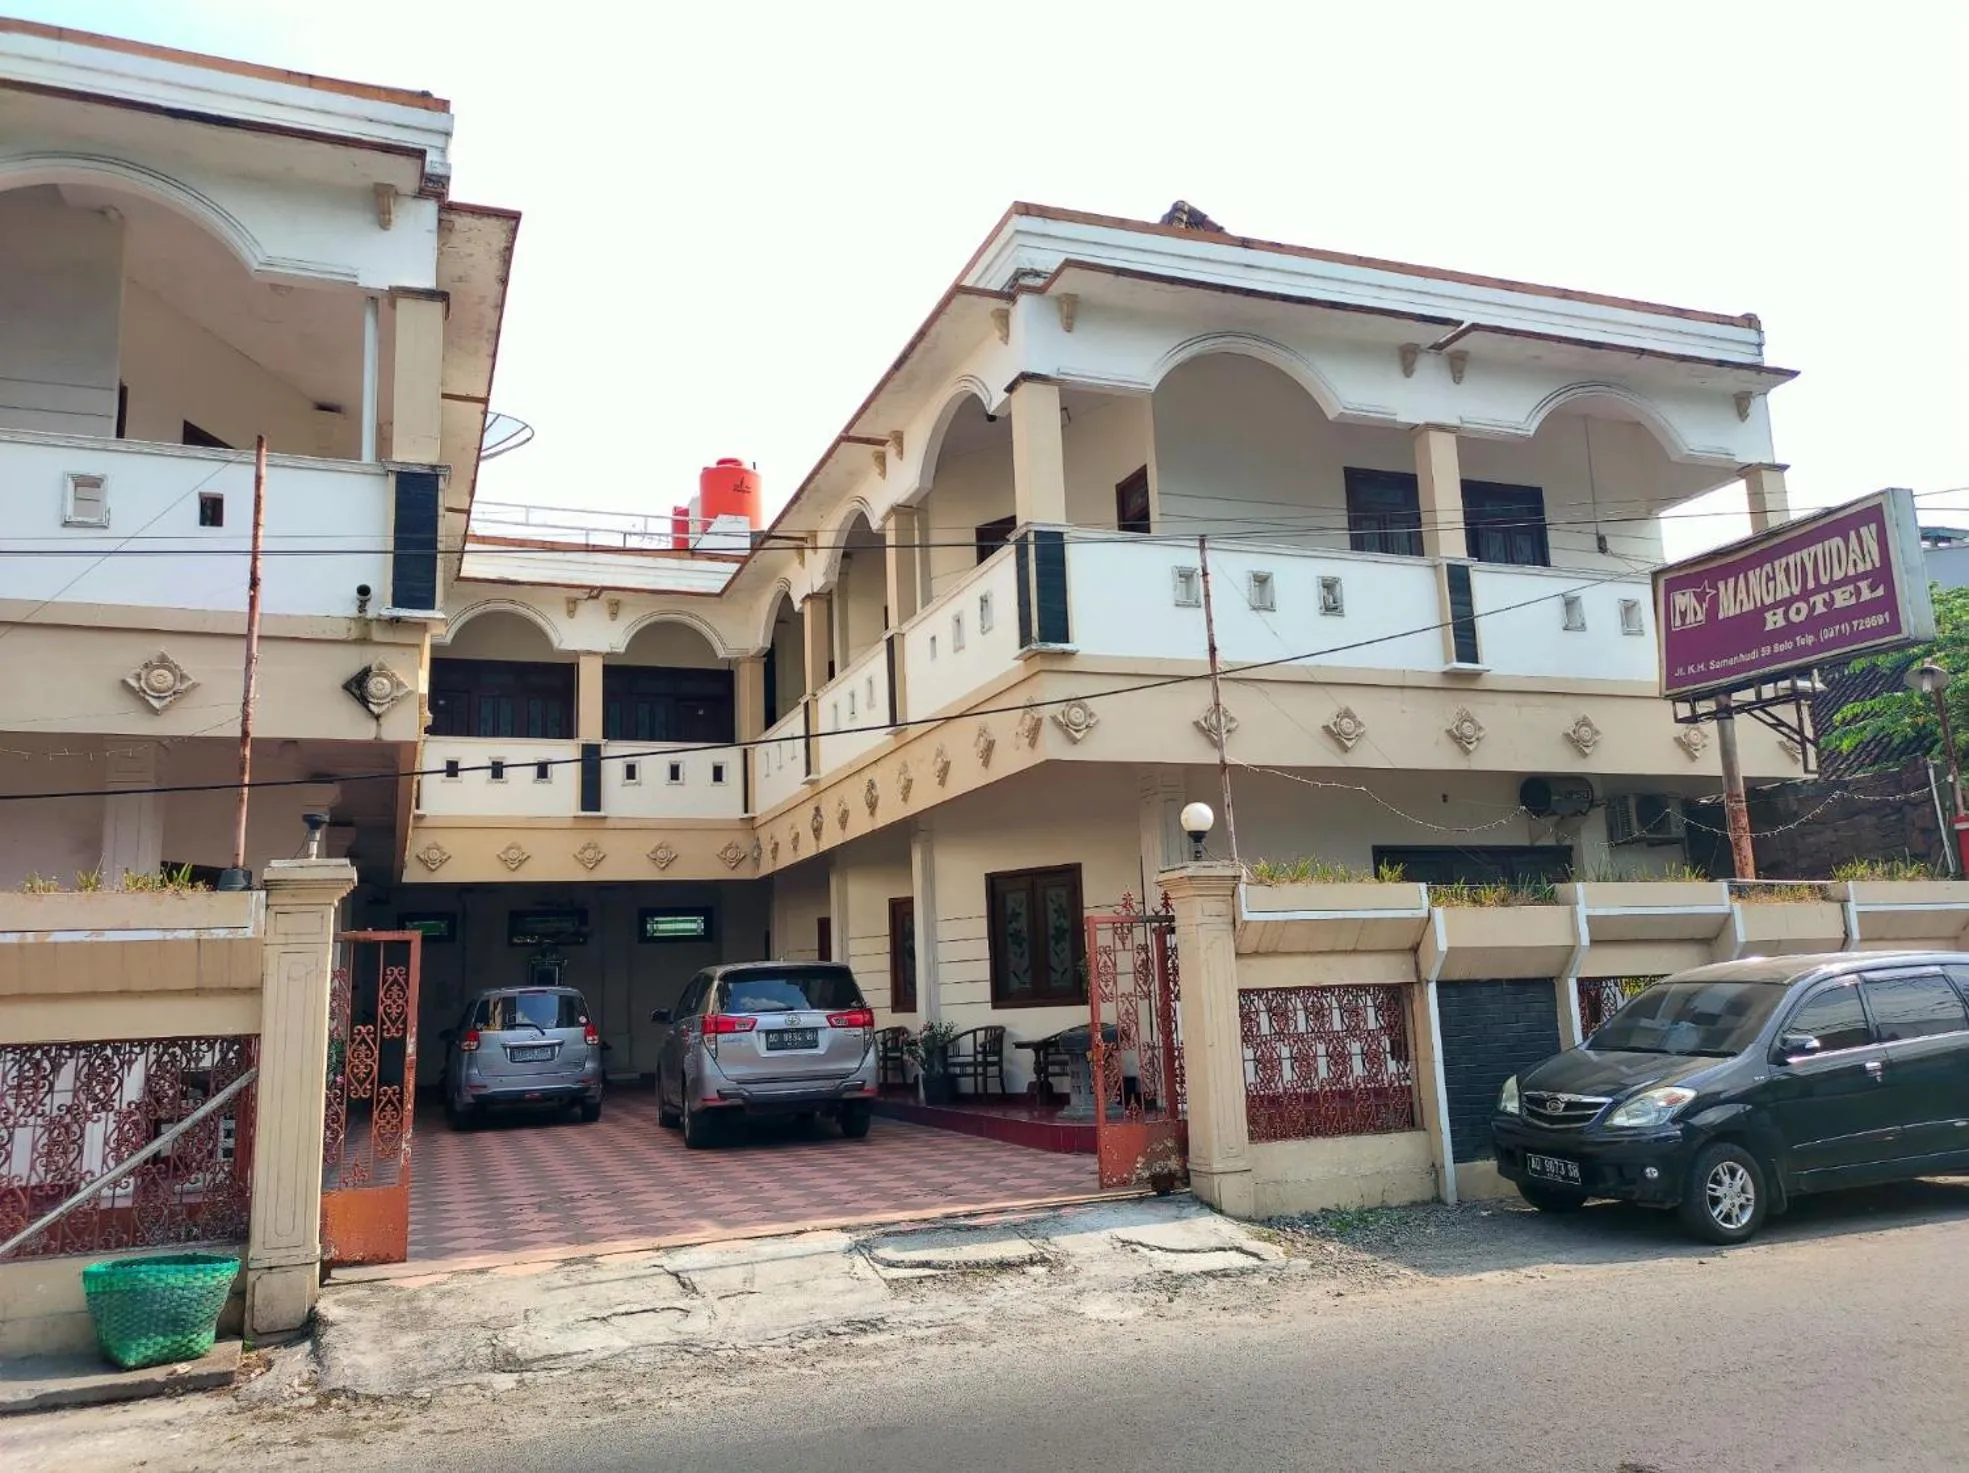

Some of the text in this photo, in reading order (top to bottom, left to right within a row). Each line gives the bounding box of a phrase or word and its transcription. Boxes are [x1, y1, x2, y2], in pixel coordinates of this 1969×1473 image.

[1717, 523, 1881, 620] MANGKUYUDAN
[1764, 578, 1884, 631] HOTEL
[1773, 640, 1793, 653] Solo
